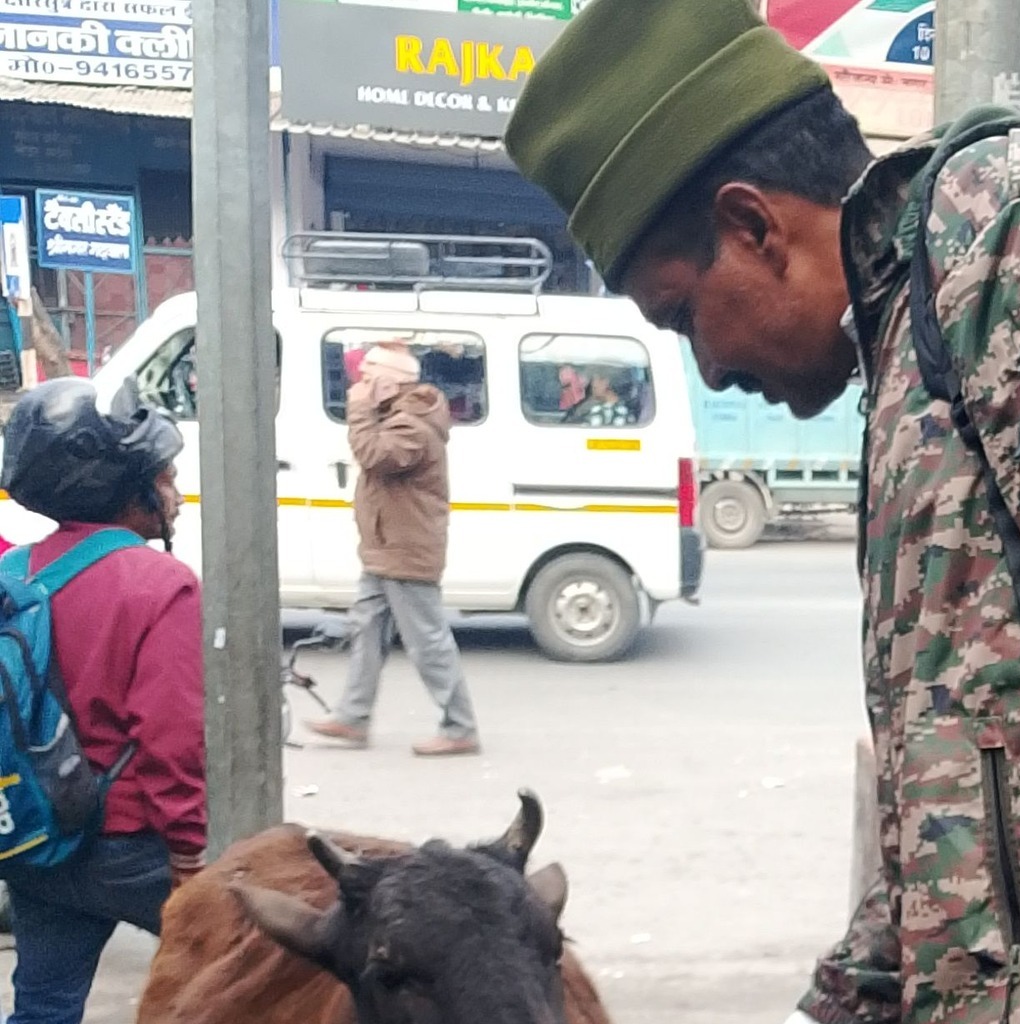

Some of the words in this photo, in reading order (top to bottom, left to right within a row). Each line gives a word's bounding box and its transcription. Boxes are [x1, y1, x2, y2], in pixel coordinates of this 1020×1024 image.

[394, 34, 537, 87] RAJKA
[357, 85, 410, 106] HOME
[414, 90, 474, 111] DECOR
[476, 95, 493, 112] &
